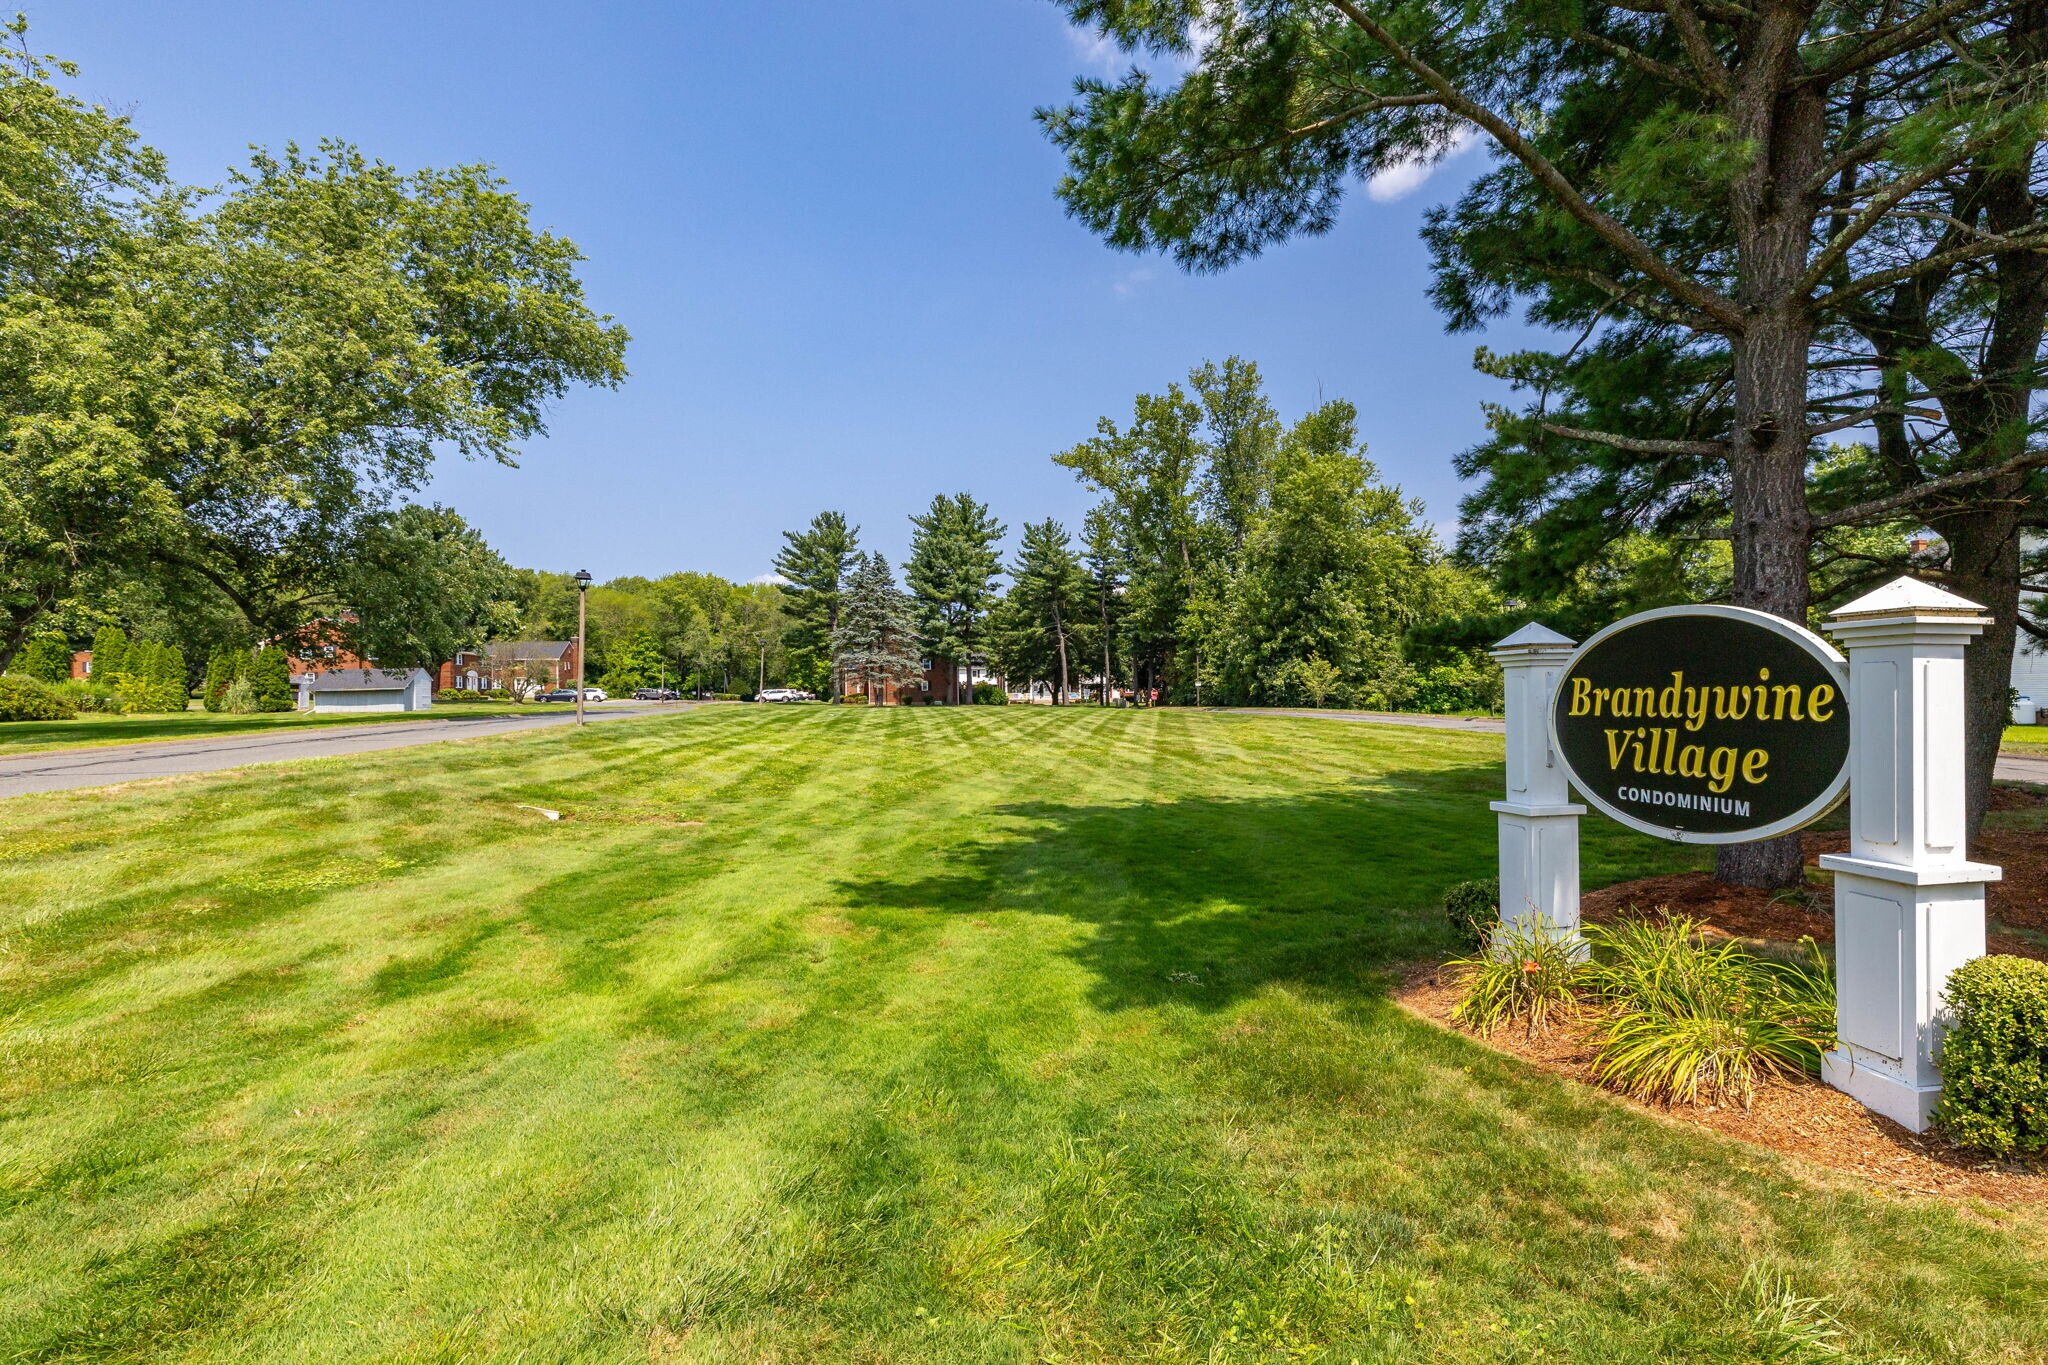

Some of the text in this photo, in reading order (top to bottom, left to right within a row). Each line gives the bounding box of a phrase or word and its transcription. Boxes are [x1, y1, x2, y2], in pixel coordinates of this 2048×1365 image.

[1568, 667, 1835, 732] Brandywine
[1604, 727, 1769, 793] Village
[1617, 786, 1750, 817] CONDOMINIUM
